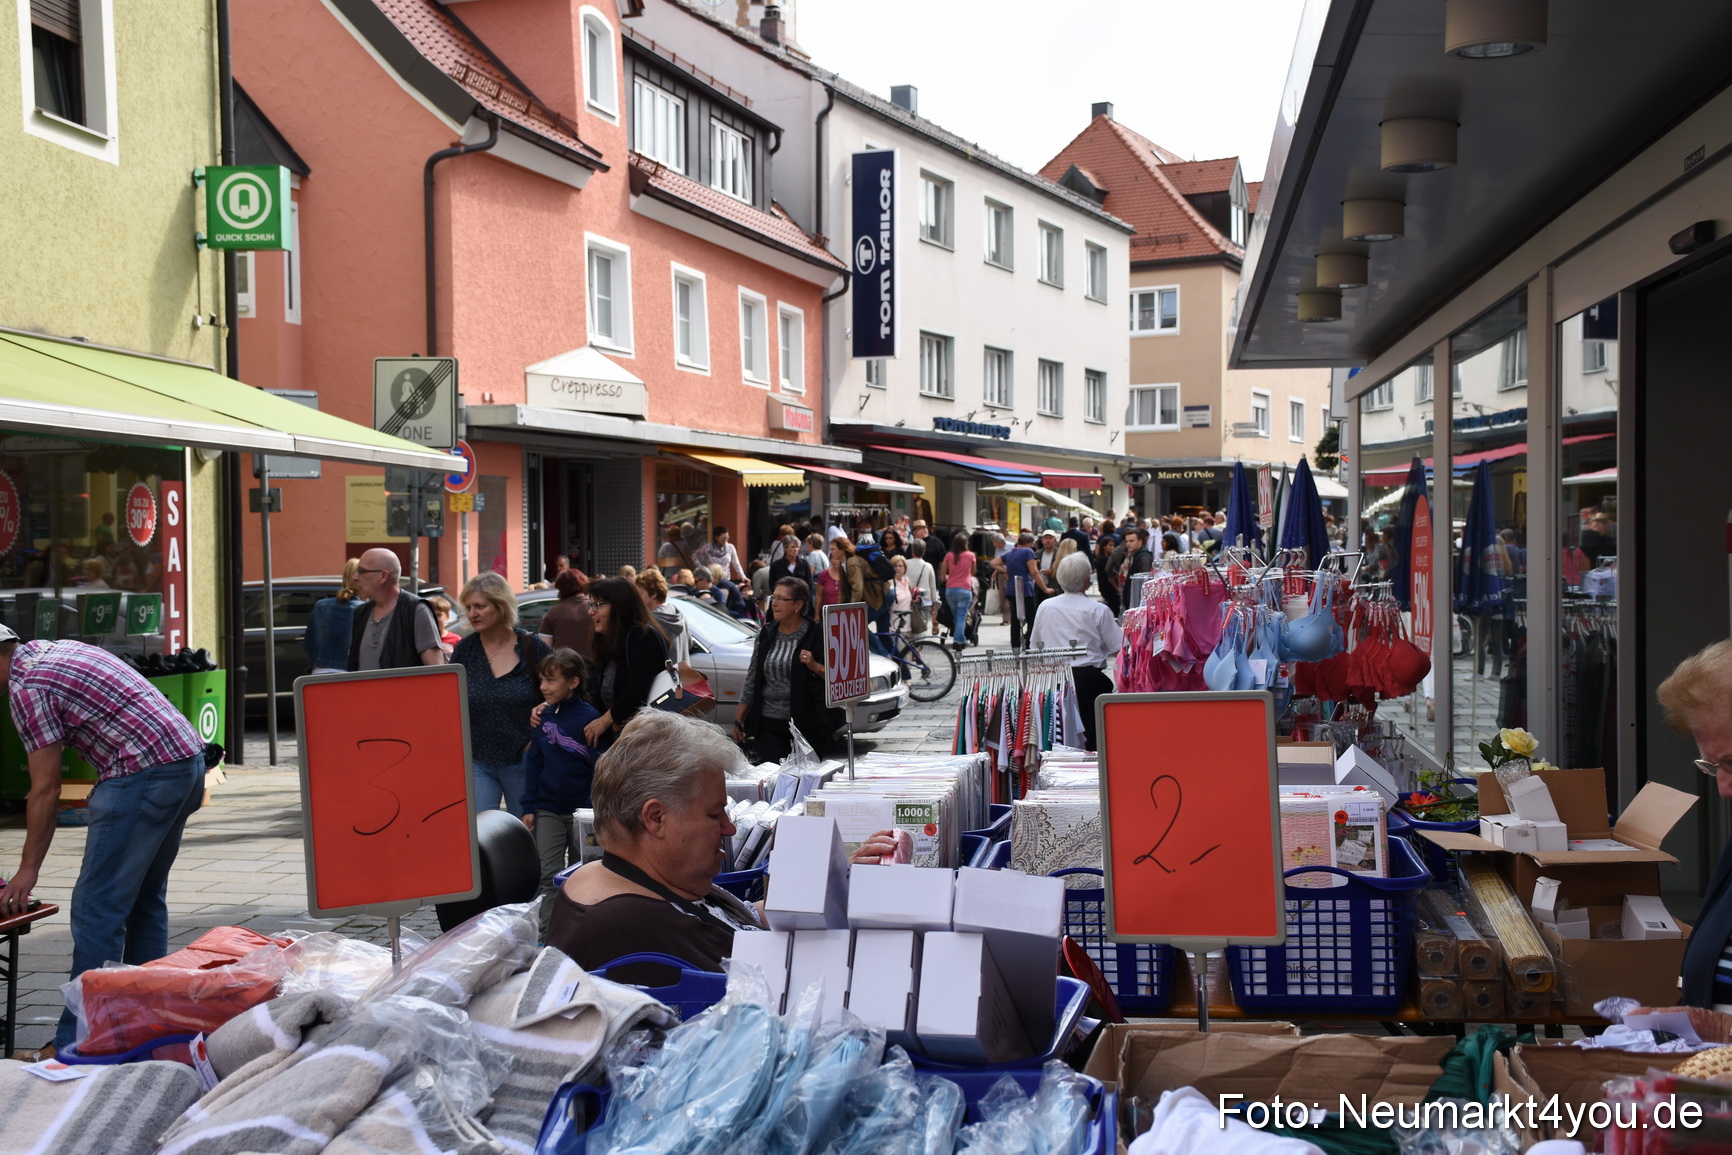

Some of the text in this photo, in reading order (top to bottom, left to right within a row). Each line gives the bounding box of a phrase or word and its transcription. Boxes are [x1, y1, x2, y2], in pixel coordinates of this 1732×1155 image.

[229, 183, 260, 219] Q
[215, 233, 275, 242] QUICK SCHUH
[880, 168, 891, 339] TOM TAILOR
[550, 377, 623, 400] Creppresso
[397, 426, 433, 441] ONE
[933, 417, 967, 433] TOM
[1158, 470, 1215, 479] Marc O'Polo
[130, 509, 153, 529] 30%
[829, 609, 866, 683] 50%
[830, 677, 866, 700] REDUZIERT
[838, 805, 879, 814] ESTELLA
